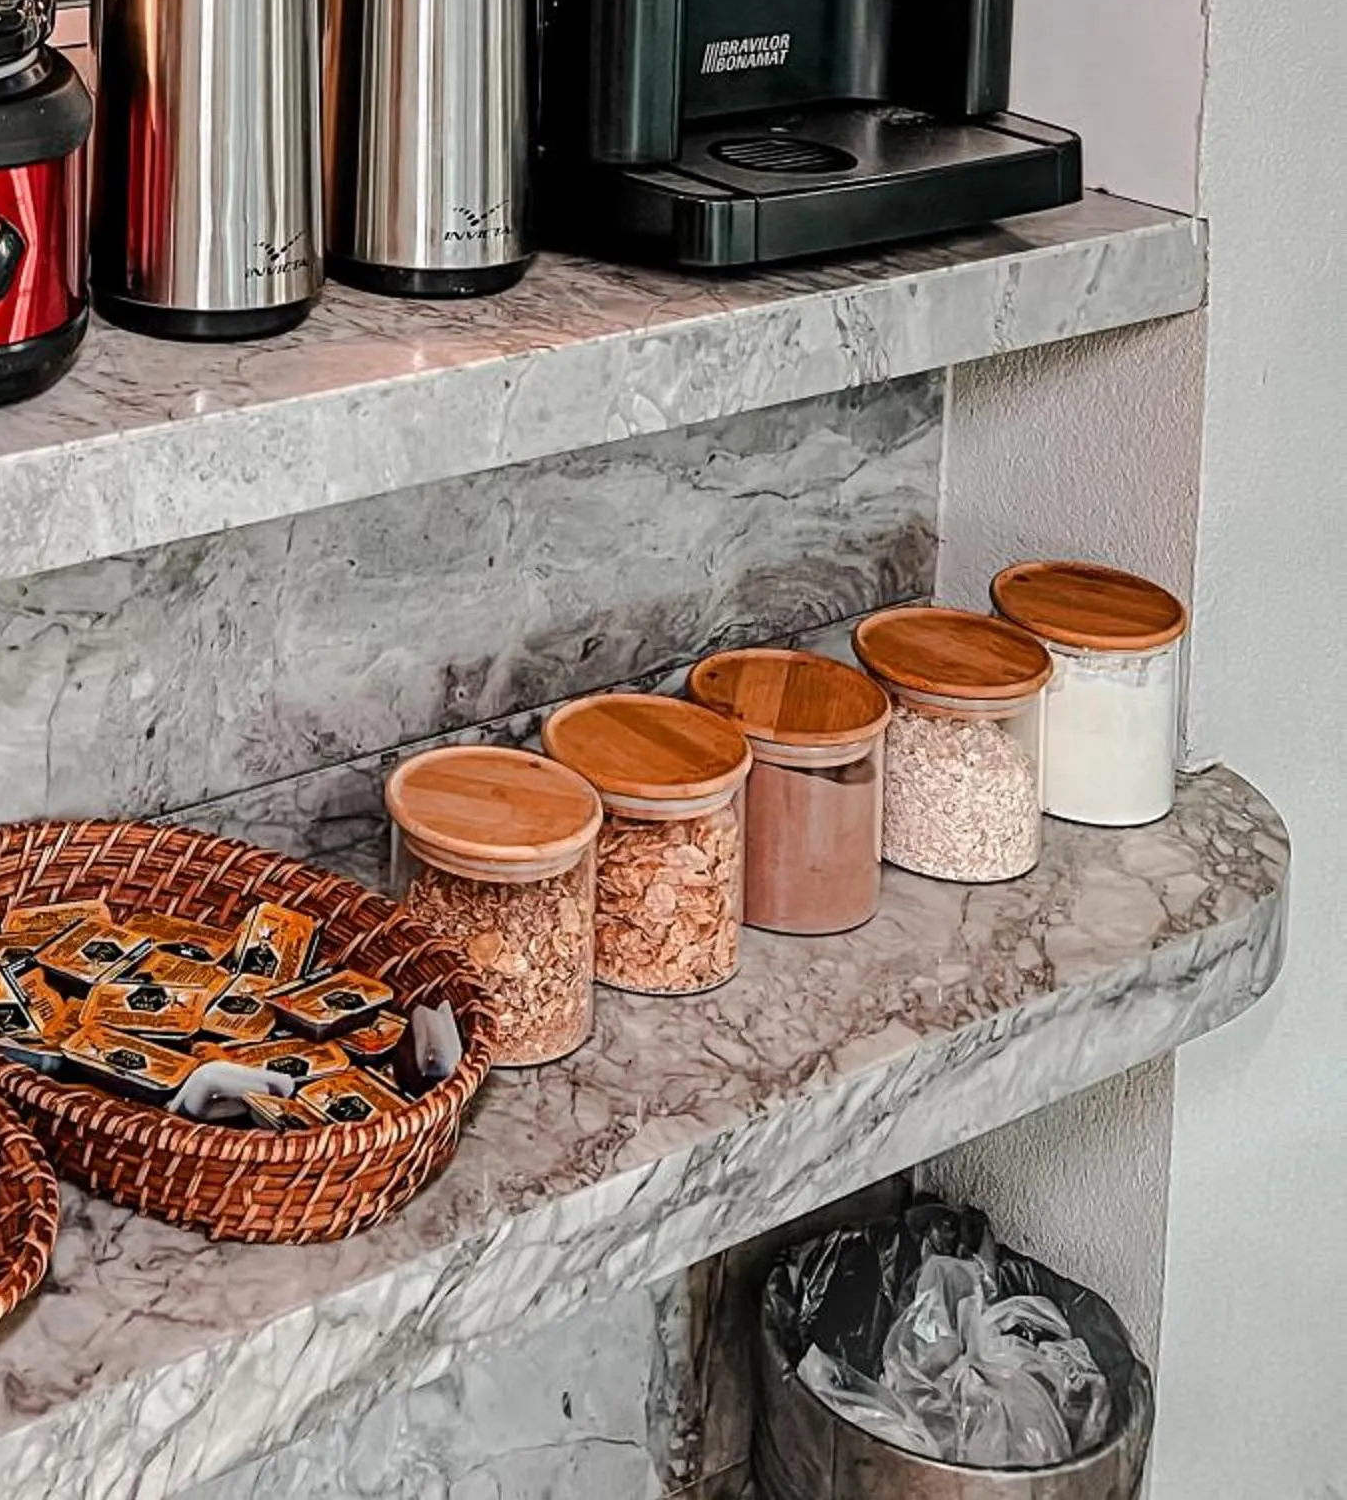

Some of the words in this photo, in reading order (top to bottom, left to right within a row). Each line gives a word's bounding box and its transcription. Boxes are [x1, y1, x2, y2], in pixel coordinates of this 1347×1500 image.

[718, 33, 791, 57] BRAVILOR
[714, 49, 789, 73] BONAMAT
[444, 226, 514, 241] INVICTA
[245, 258, 310, 278] INVICTA
